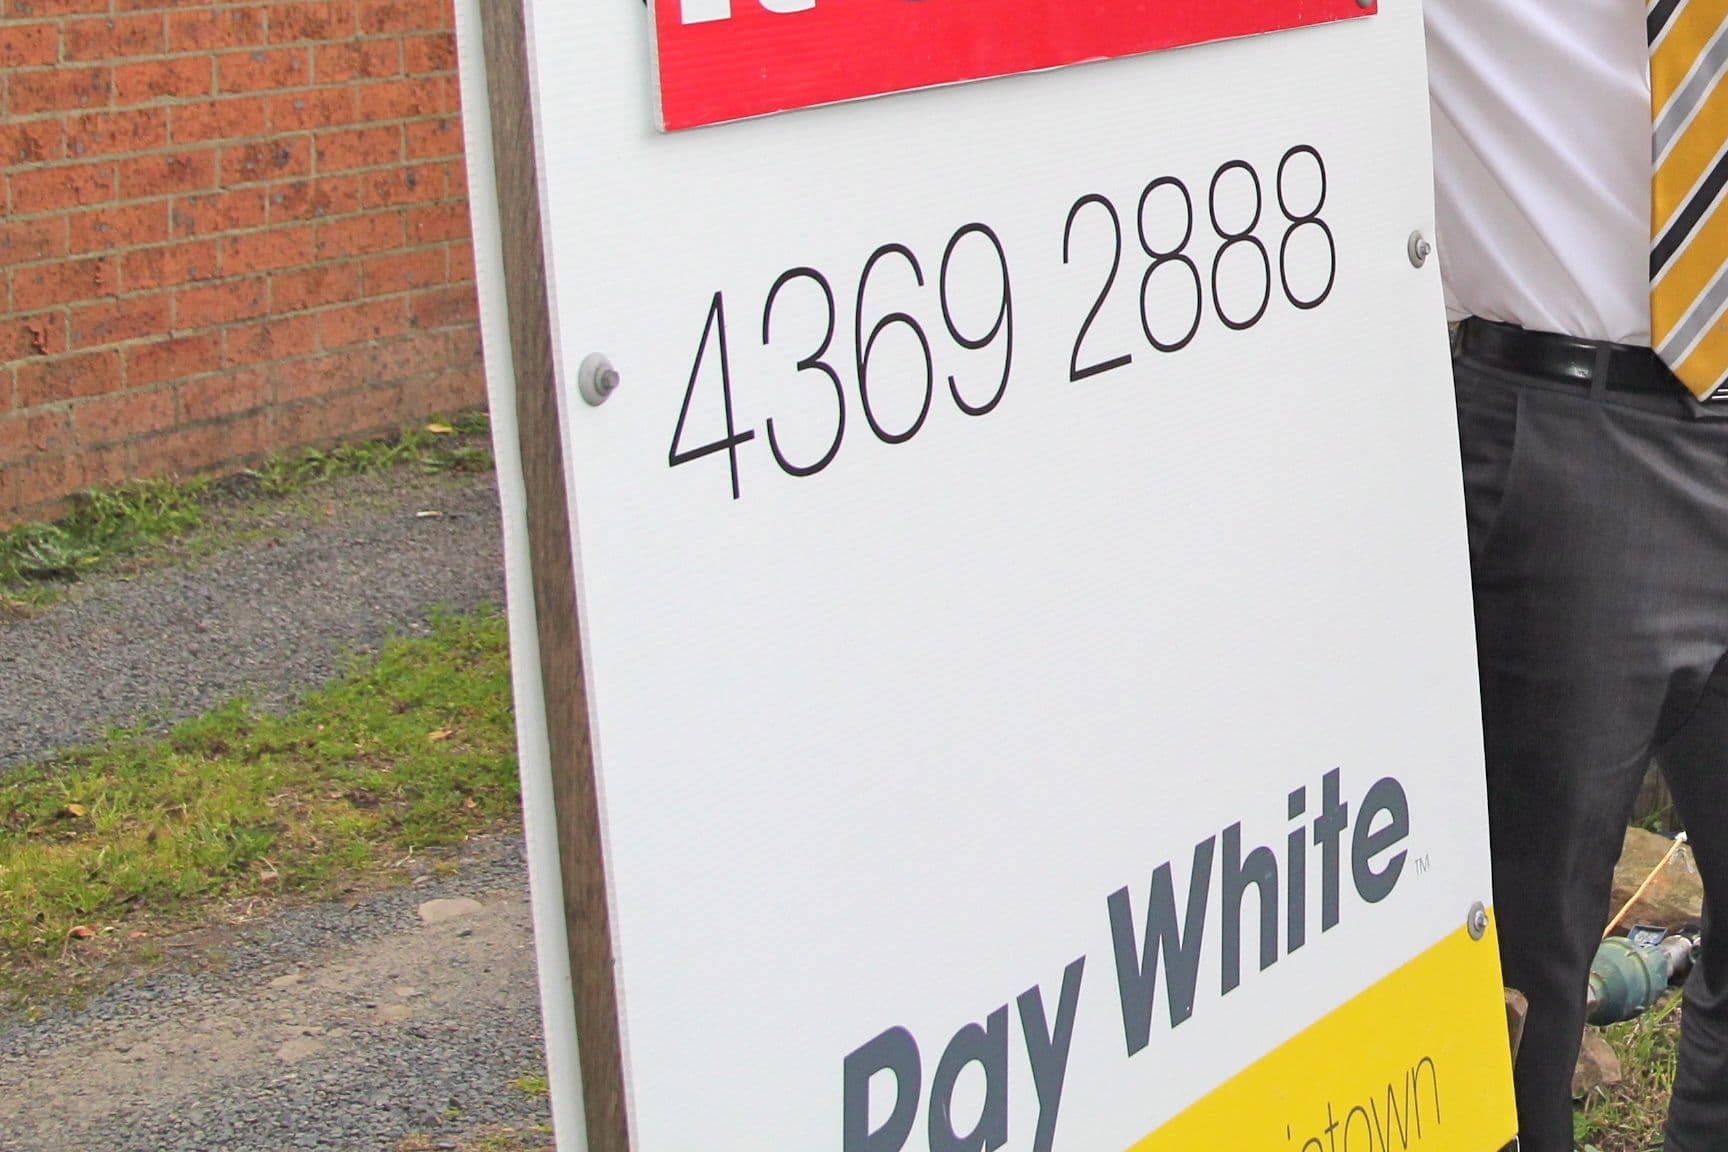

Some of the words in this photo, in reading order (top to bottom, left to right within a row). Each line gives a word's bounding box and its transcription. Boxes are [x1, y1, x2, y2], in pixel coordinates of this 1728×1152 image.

[668, 221, 1014, 500] 4369
[1062, 143, 1337, 383] 2888
[1107, 767, 1411, 1058] White
